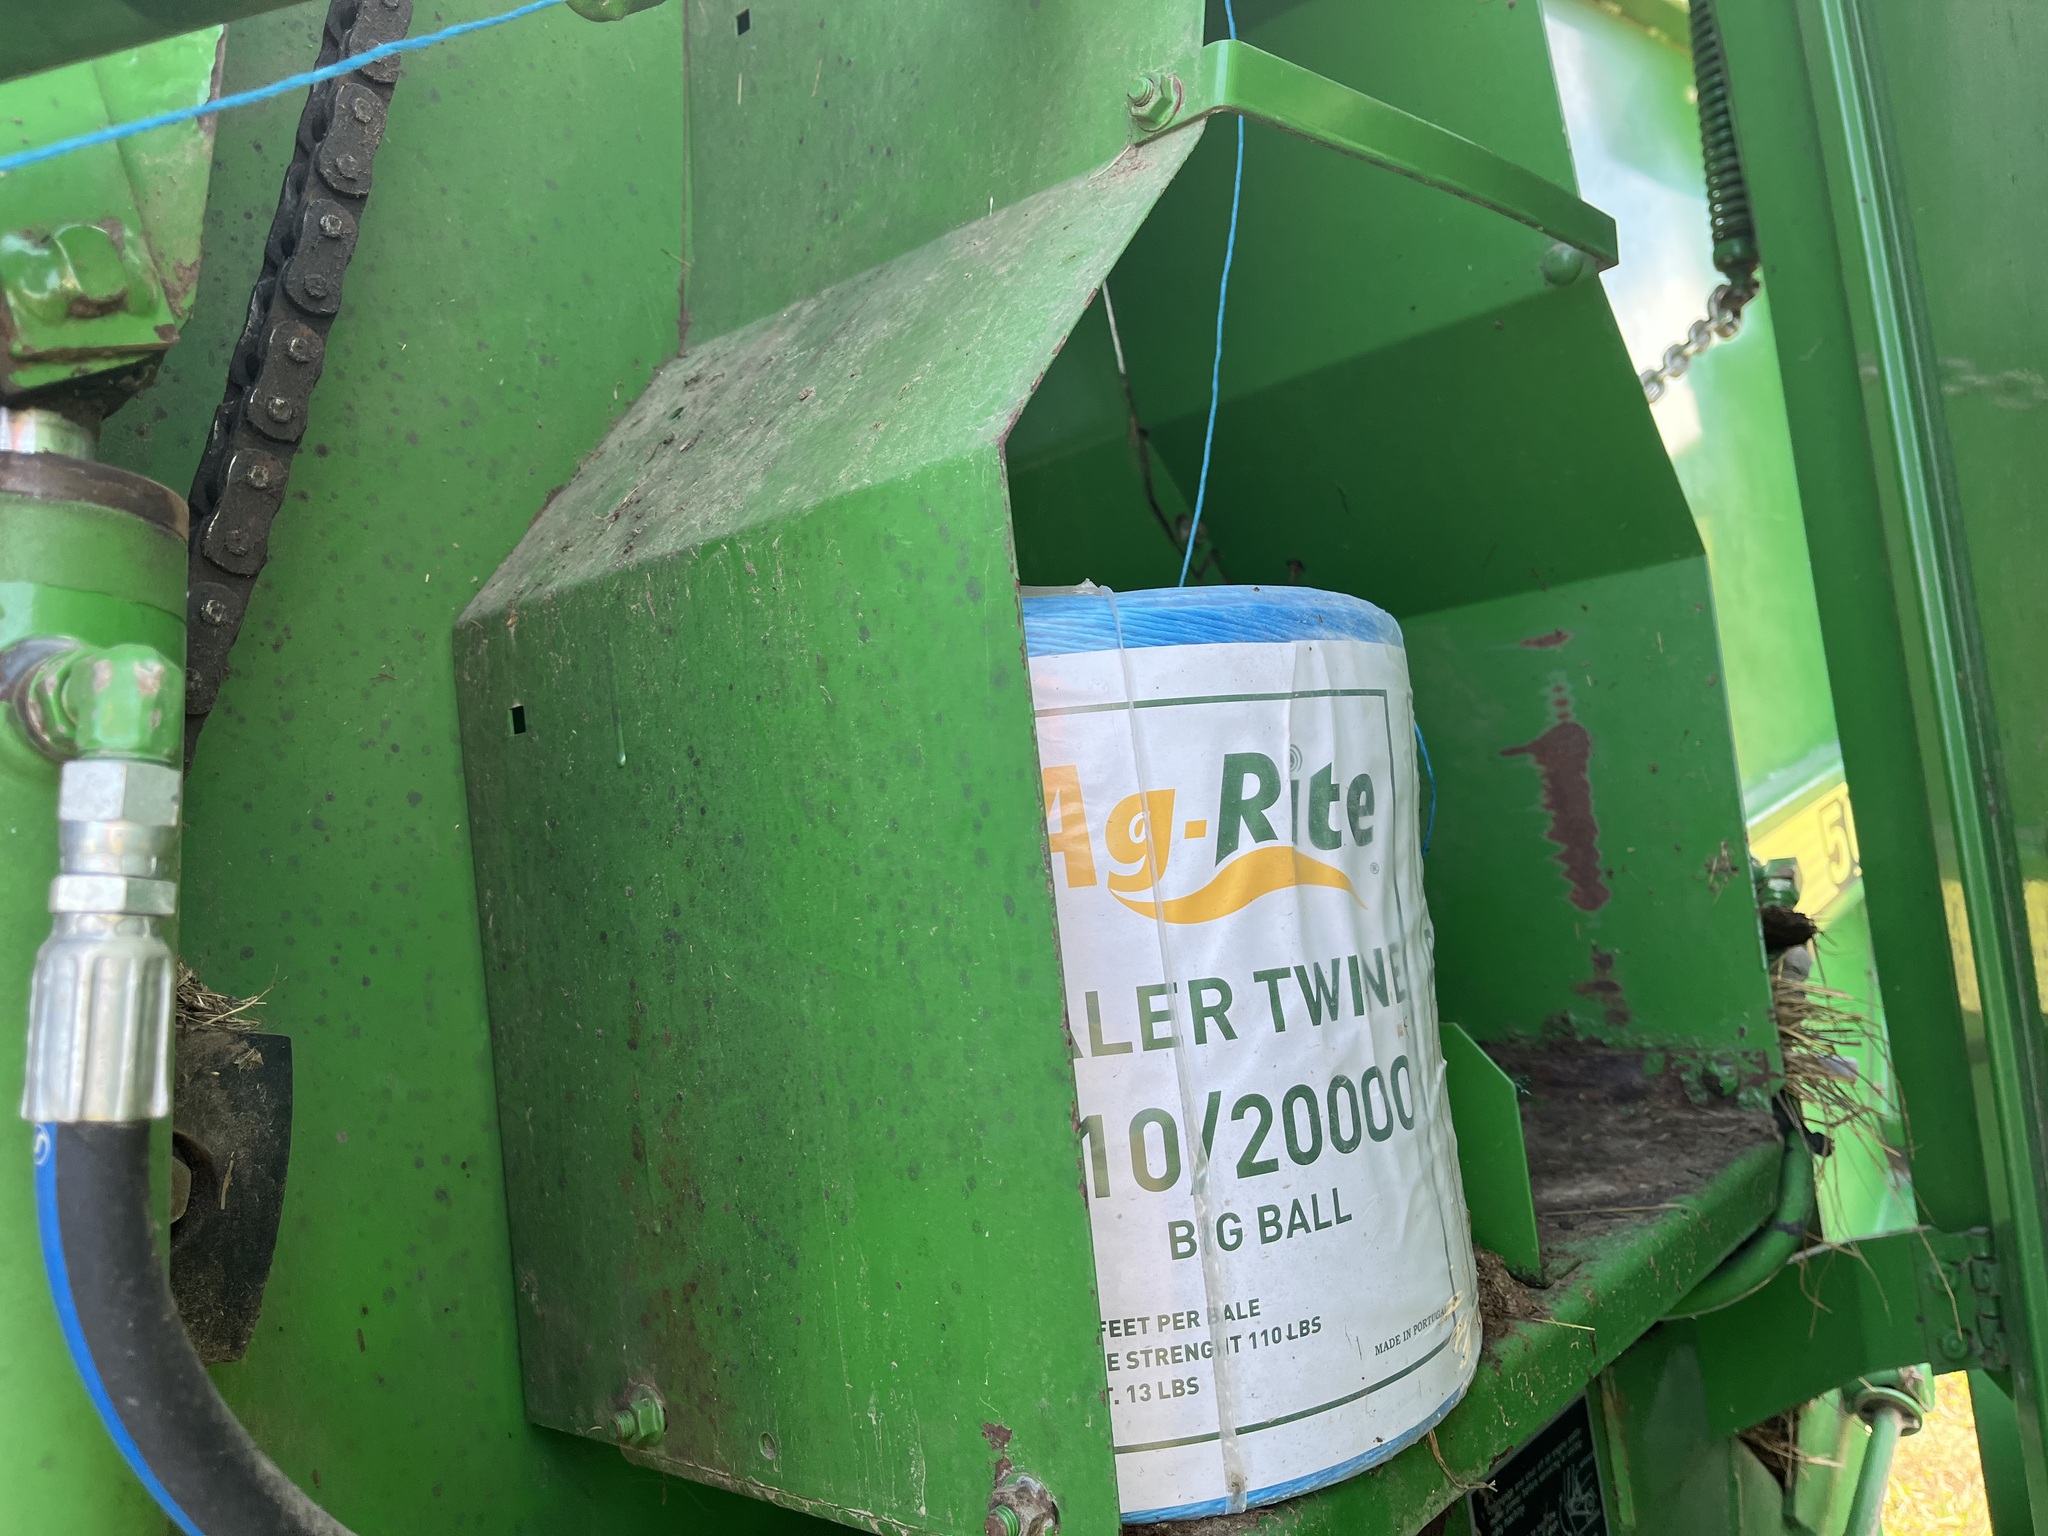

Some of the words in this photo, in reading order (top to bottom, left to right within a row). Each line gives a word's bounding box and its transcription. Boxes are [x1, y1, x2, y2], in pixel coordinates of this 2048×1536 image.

[1041, 745, 1376, 892] Ag-Rite
[1072, 976, 1239, 1059] LER
[1253, 941, 1407, 1034] TWINE
[1257, 1187, 1353, 1246] BALL
[1106, 1352, 1121, 1372] E
[1249, 1327, 1282, 1350] 110
[1287, 1316, 1323, 1342] LBS
[1157, 1310, 1201, 1333] PER
[1374, 1334, 1402, 1356] MADE
[1402, 1326, 1412, 1341] IN
[1126, 1383, 1152, 1404] 13
[1157, 1376, 1200, 1401] LBS
